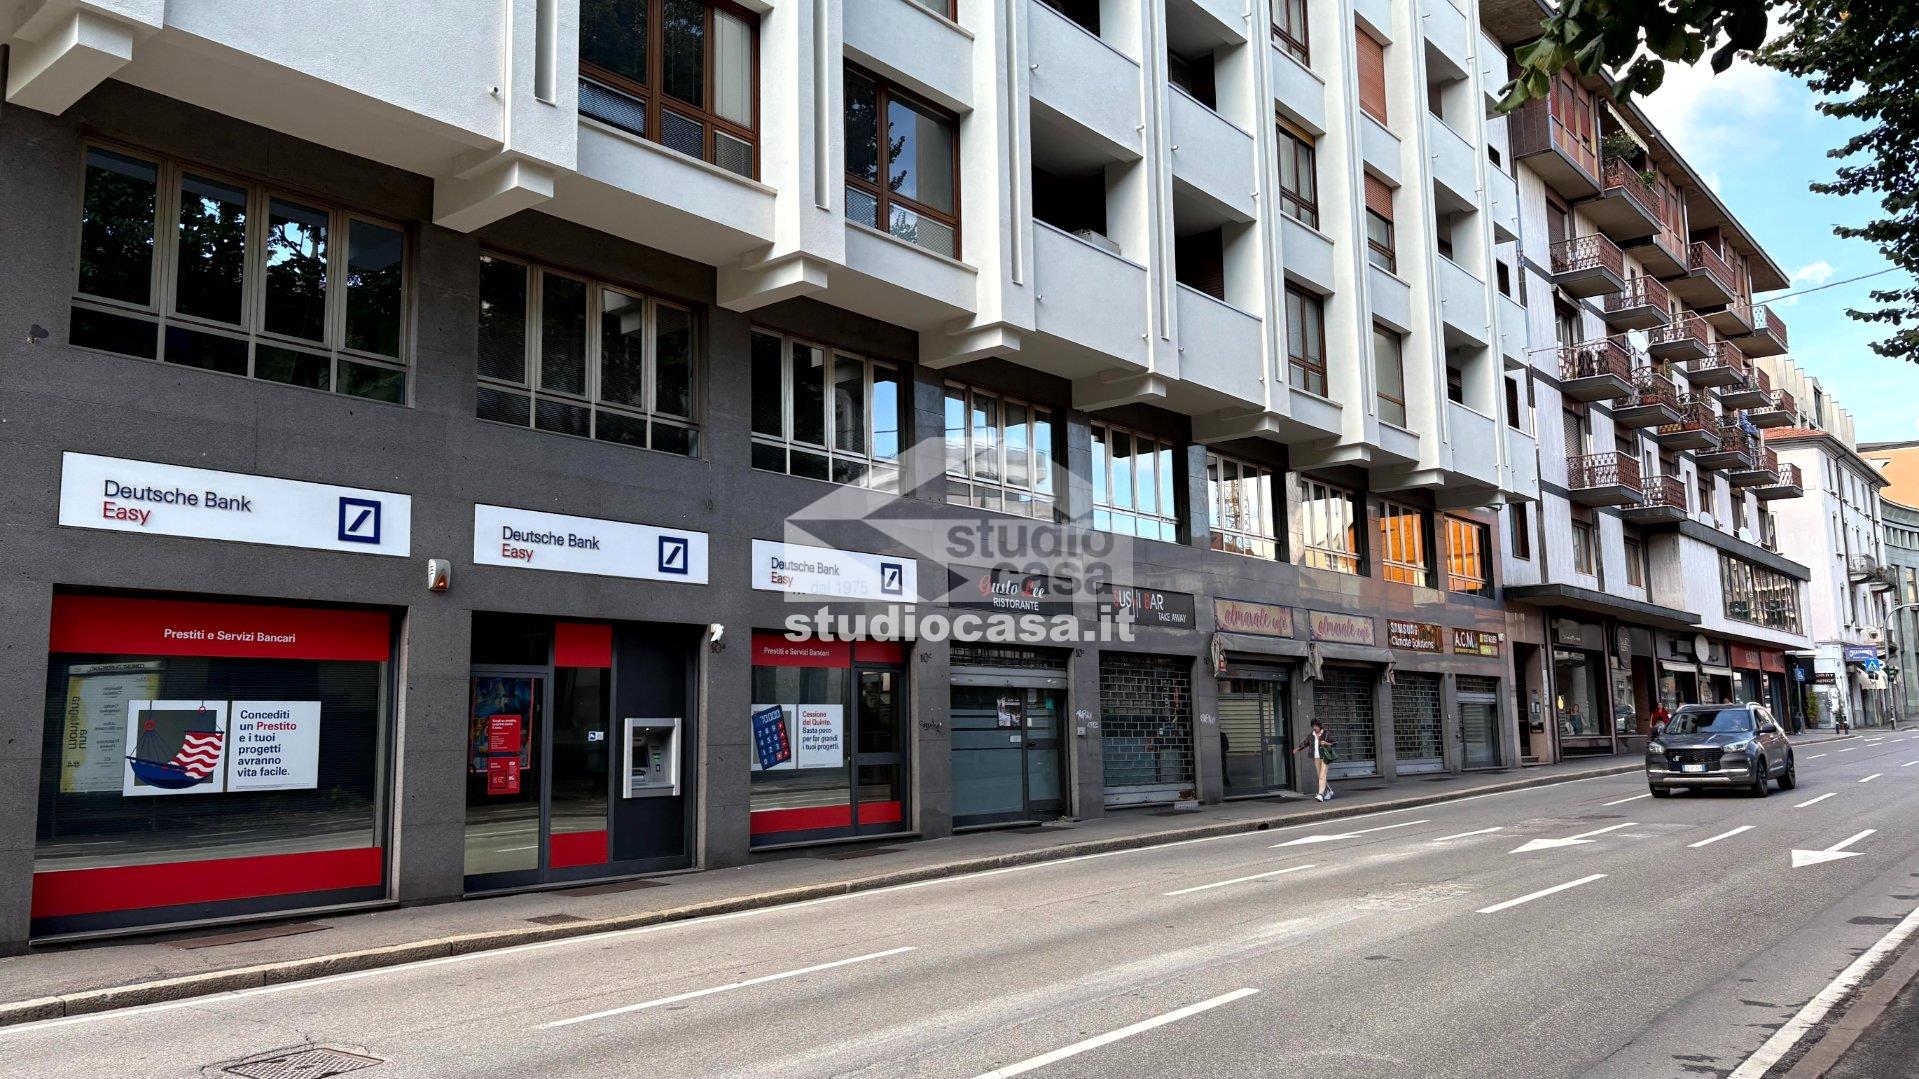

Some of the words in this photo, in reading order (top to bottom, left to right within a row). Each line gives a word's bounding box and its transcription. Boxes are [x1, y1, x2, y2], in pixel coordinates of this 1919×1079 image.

[104, 479, 199, 506] Deutsche
[204, 491, 253, 513] Bank
[102, 501, 151, 526] Easy
[502, 526, 565, 546] Deutsche
[568, 533, 600, 550] Bank
[501, 543, 534, 562] Easy
[771, 556, 815, 574] Deutsche
[817, 562, 840, 576] Bank
[771, 571, 794, 588] Easy
[978, 575, 1018, 597] Gusto
[992, 598, 1039, 612] RISTORANTE
[1113, 589, 1142, 618] SUSHI
[1144, 593, 1164, 610] BAR
[1157, 612, 1171, 622] TAKE
[1171, 613, 1187, 623] AWAY
[163, 628, 205, 640] Prestiti
[207, 632, 214, 640] e
[217, 630, 254, 642] Servizi
[257, 632, 296, 643] Bancari
[1390, 622, 1418, 636] SAMSUNG
[763, 646, 785, 655] Prestiti
[789, 648, 809, 656] Servizi
[809, 649, 830, 657] Bancari
[240, 709, 290, 720] Concediti
[239, 723, 254, 731] un
[256, 721, 297, 731] Prestito
[239, 734, 246, 742] e
[254, 733, 276, 742] tuoi
[820, 734, 838, 743] grandi
[238, 744, 281, 756] progetti
[817, 743, 840, 751] progetti.
[237, 757, 282, 766] avranno
[237, 767, 257, 777] vita
[260, 767, 290, 776] facile.
